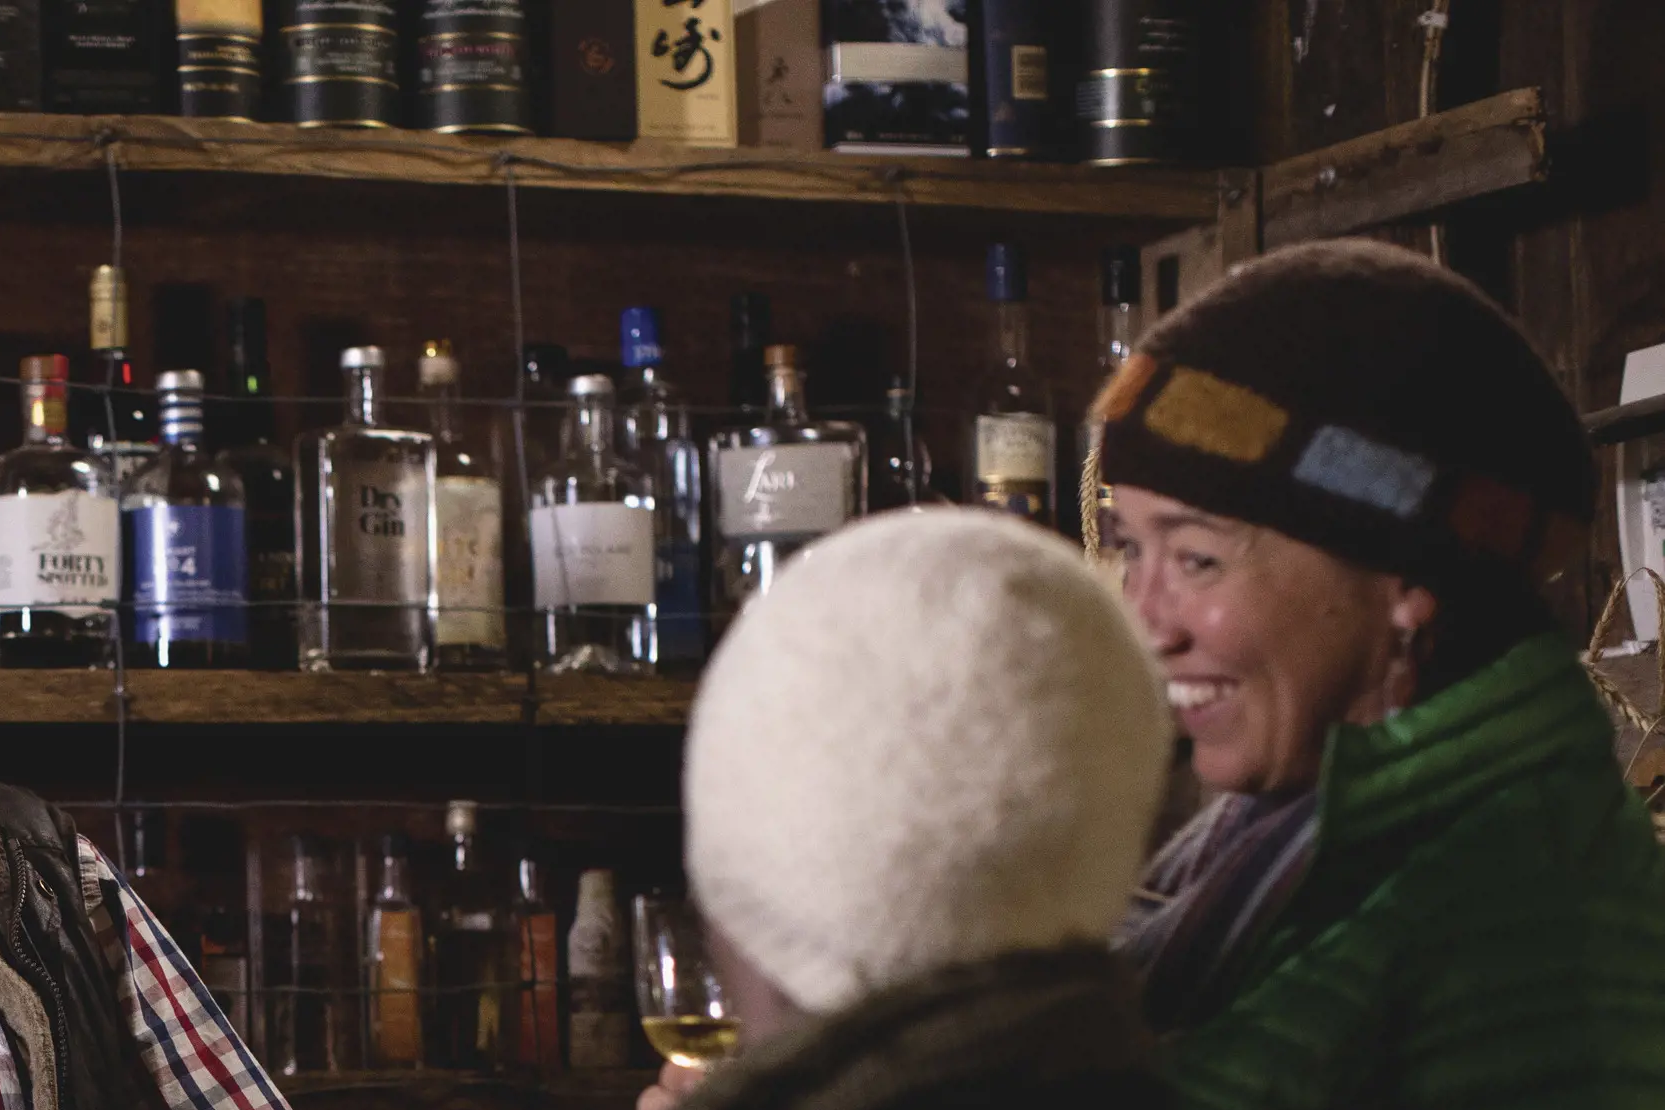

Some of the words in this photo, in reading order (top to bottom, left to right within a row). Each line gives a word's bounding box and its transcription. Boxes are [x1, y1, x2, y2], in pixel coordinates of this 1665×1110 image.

[360, 485, 401, 514] Dry
[359, 513, 405, 537] Gin
[38, 553, 104, 573] FORTY
[36, 571, 109, 588] SPOTTED
